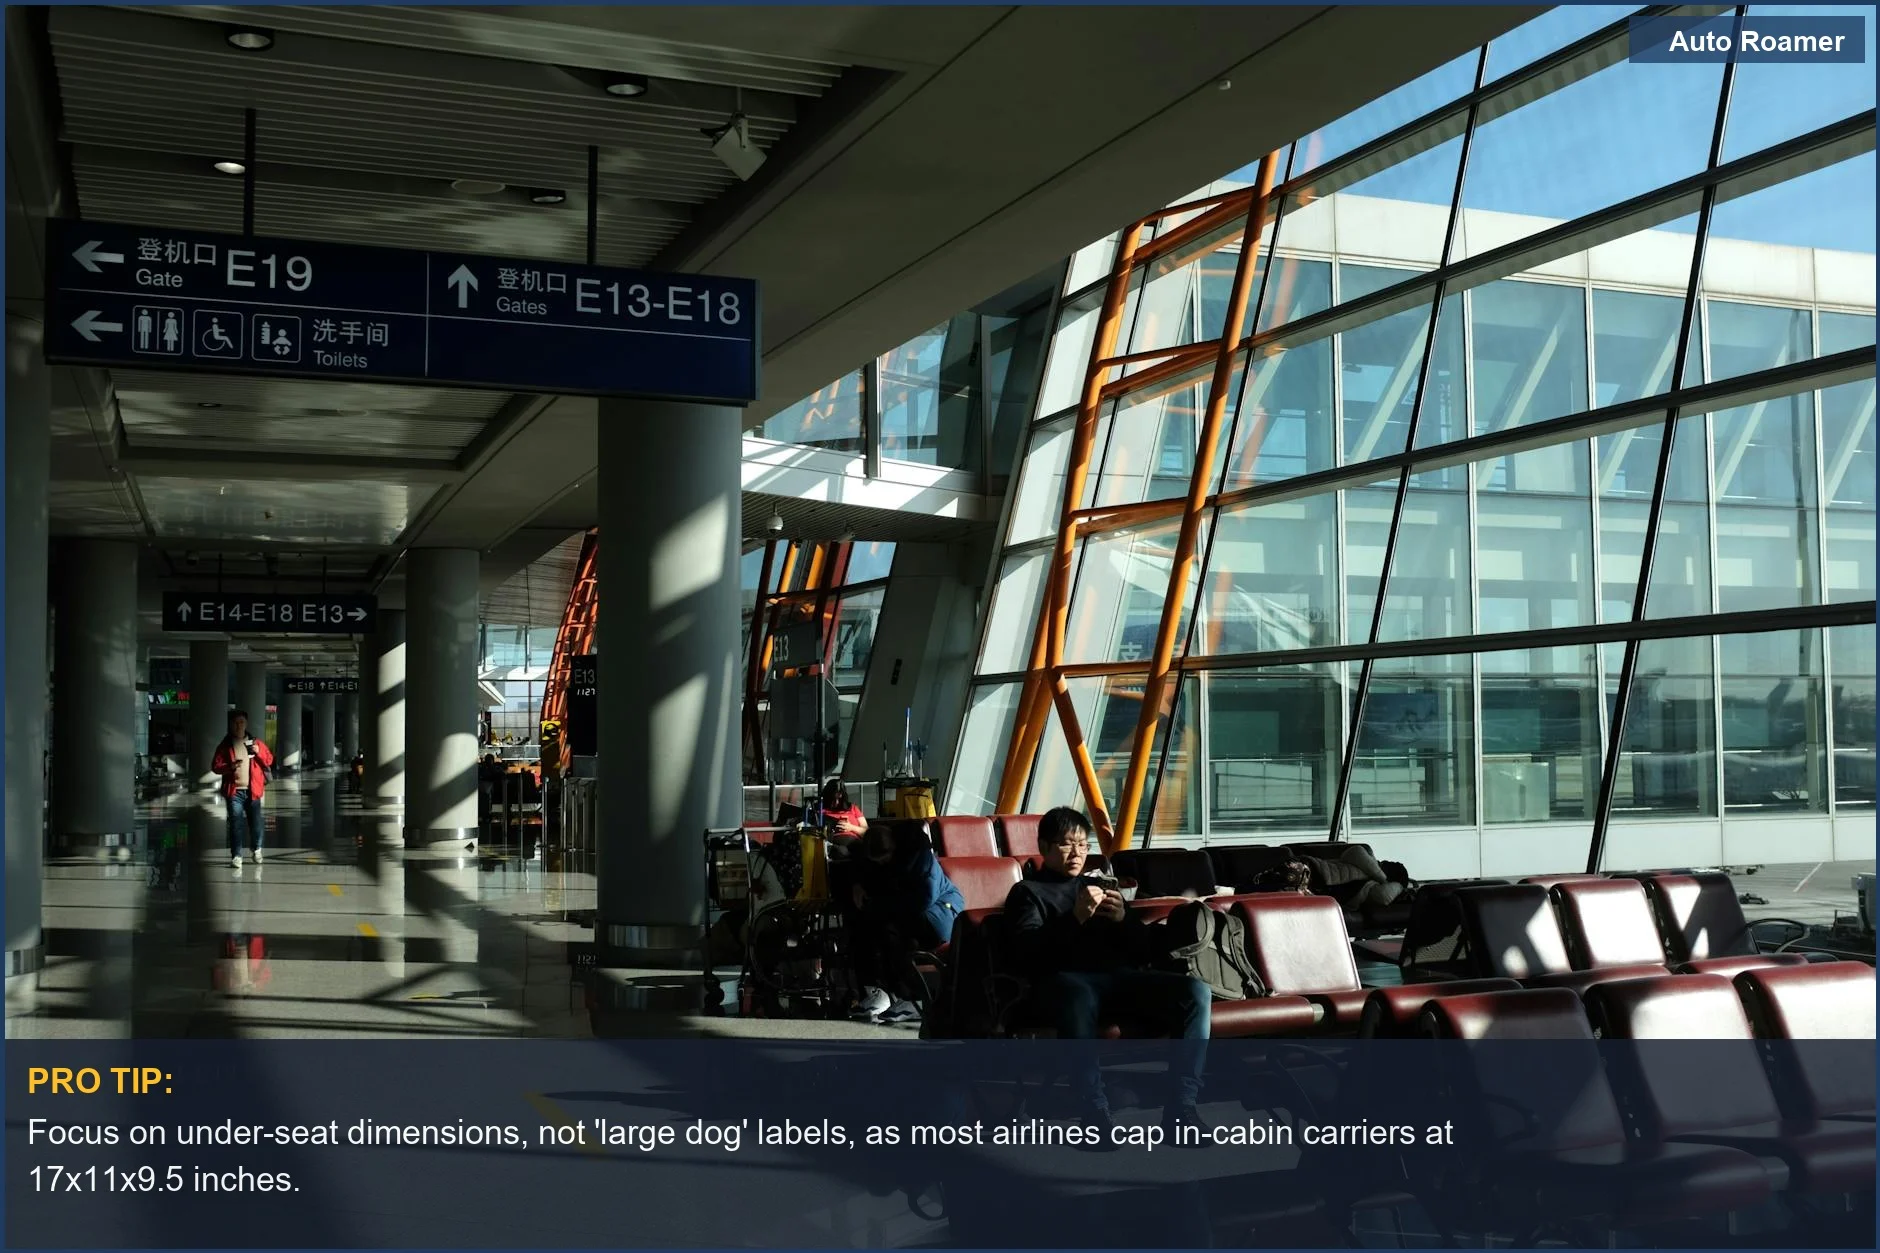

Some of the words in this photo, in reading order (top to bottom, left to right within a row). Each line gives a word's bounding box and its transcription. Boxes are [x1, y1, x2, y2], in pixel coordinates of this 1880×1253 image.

[137, 237, 217, 266] 登机口
[135, 268, 183, 288] Gate
[226, 249, 313, 292] E19
[497, 267, 567, 294] 登机口
[496, 296, 548, 316] Gates
[576, 277, 741, 325] E13-E18
[312, 317, 389, 348] 洗手间
[313, 349, 368, 369] Toilets
[200, 601, 293, 623] E14-E18
[302, 603, 343, 623] E13
[774, 633, 789, 662] E13
[328, 681, 359, 691] E14-E1
[574, 668, 595, 685] E13
